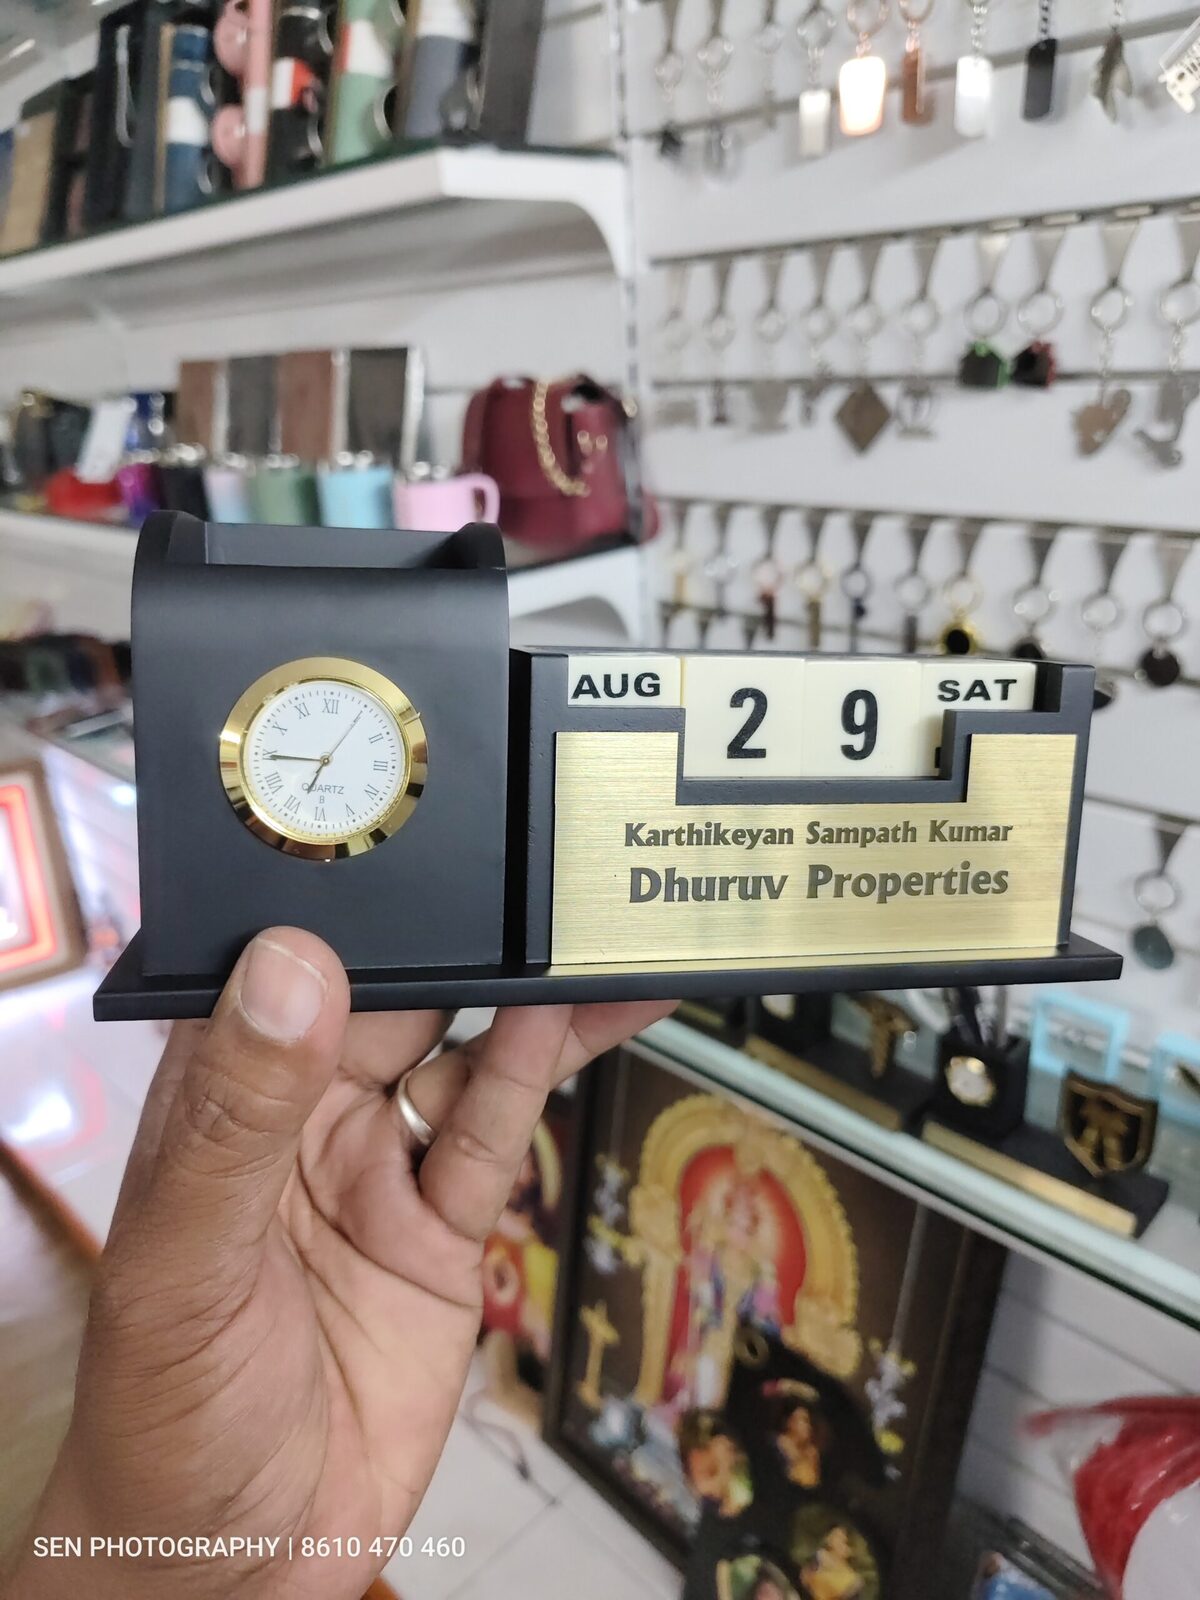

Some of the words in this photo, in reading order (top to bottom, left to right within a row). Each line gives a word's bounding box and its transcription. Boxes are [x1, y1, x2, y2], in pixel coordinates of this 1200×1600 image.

[294, 702, 311, 720] XI
[322, 698, 340, 714] XII
[571, 672, 661, 699] AUG
[726, 687, 769, 760] 2
[840, 689, 879, 761] 9
[937, 678, 1018, 702] SAT
[272, 721, 288, 737] X
[368, 732, 384, 744] II
[373, 760, 388, 772] III
[301, 782, 345, 795] QUARTZ
[283, 794, 301, 815] VII
[344, 803, 355, 818] V
[314, 806, 326, 822] VI
[624, 821, 794, 851] Karthikeyan
[806, 820, 918, 848] Sampath
[928, 819, 1014, 843] Kumar
[629, 866, 789, 904] Dhuruv
[806, 860, 1009, 904] Properties
